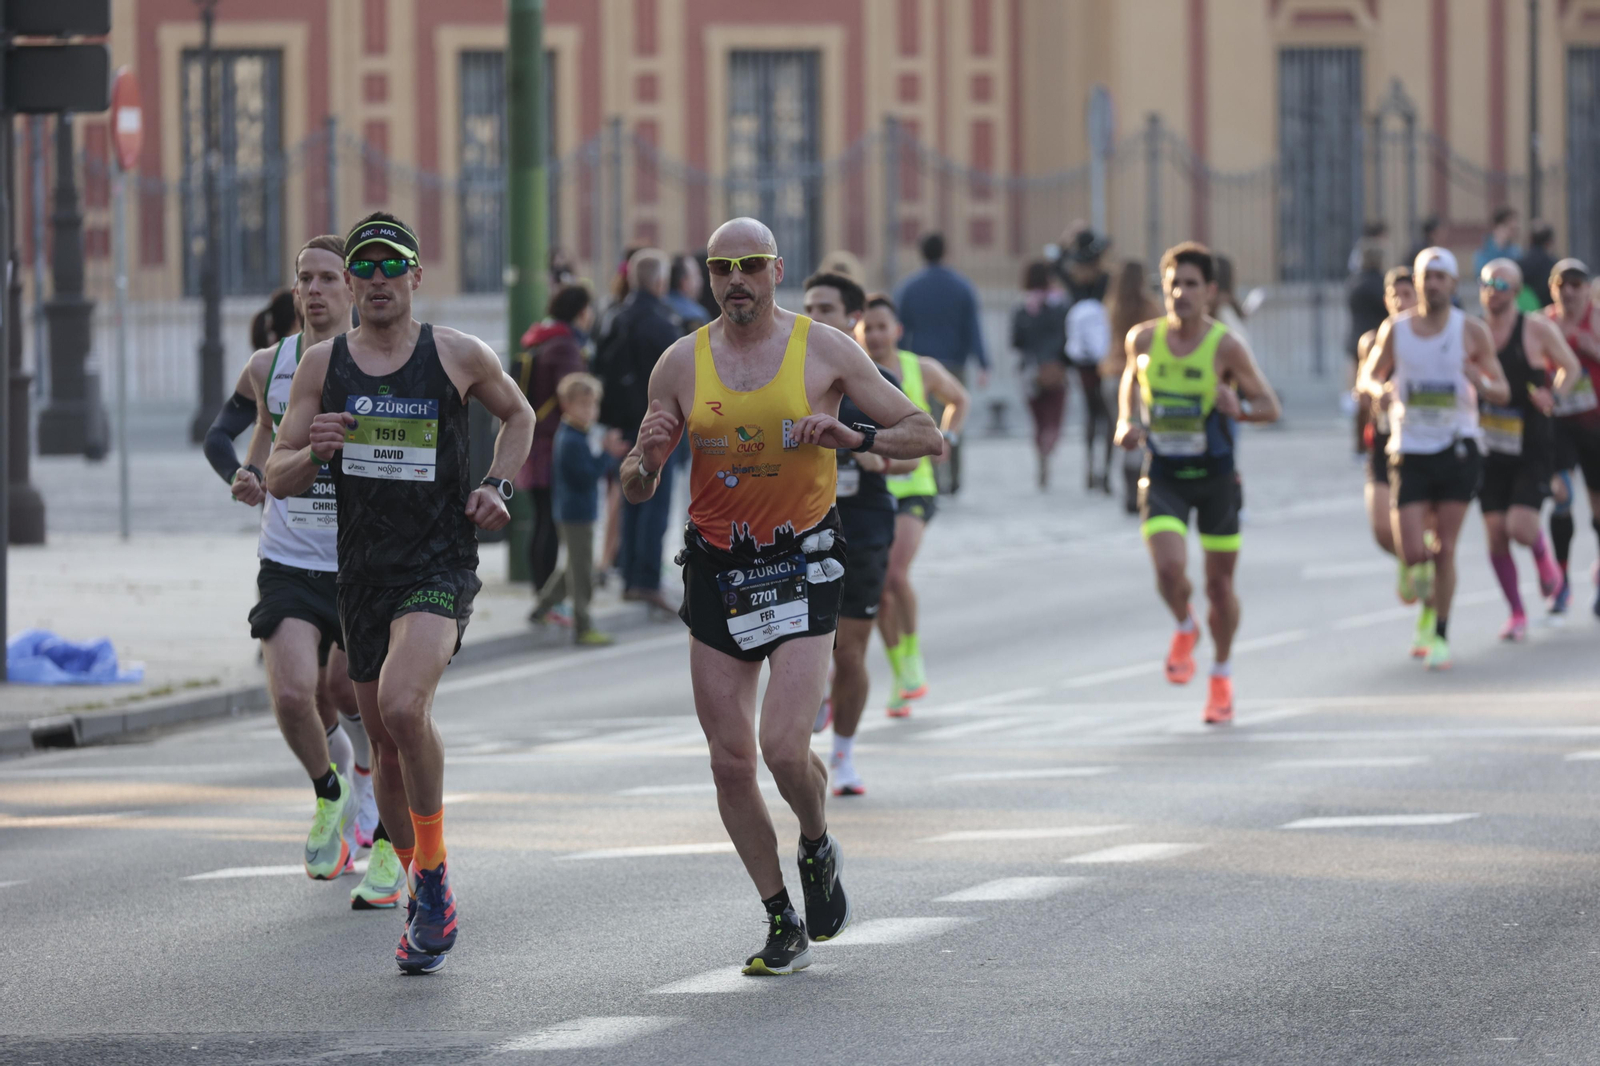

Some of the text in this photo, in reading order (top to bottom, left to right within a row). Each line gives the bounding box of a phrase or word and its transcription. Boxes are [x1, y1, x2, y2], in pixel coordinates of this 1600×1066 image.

[375, 427, 406, 441] 1519
[373, 448, 404, 460] DAVID
[427, 590, 455, 602] TEAM
[749, 588, 778, 606] 2701
[399, 596, 455, 614] ARDONA
[760, 609, 776, 623] FER
